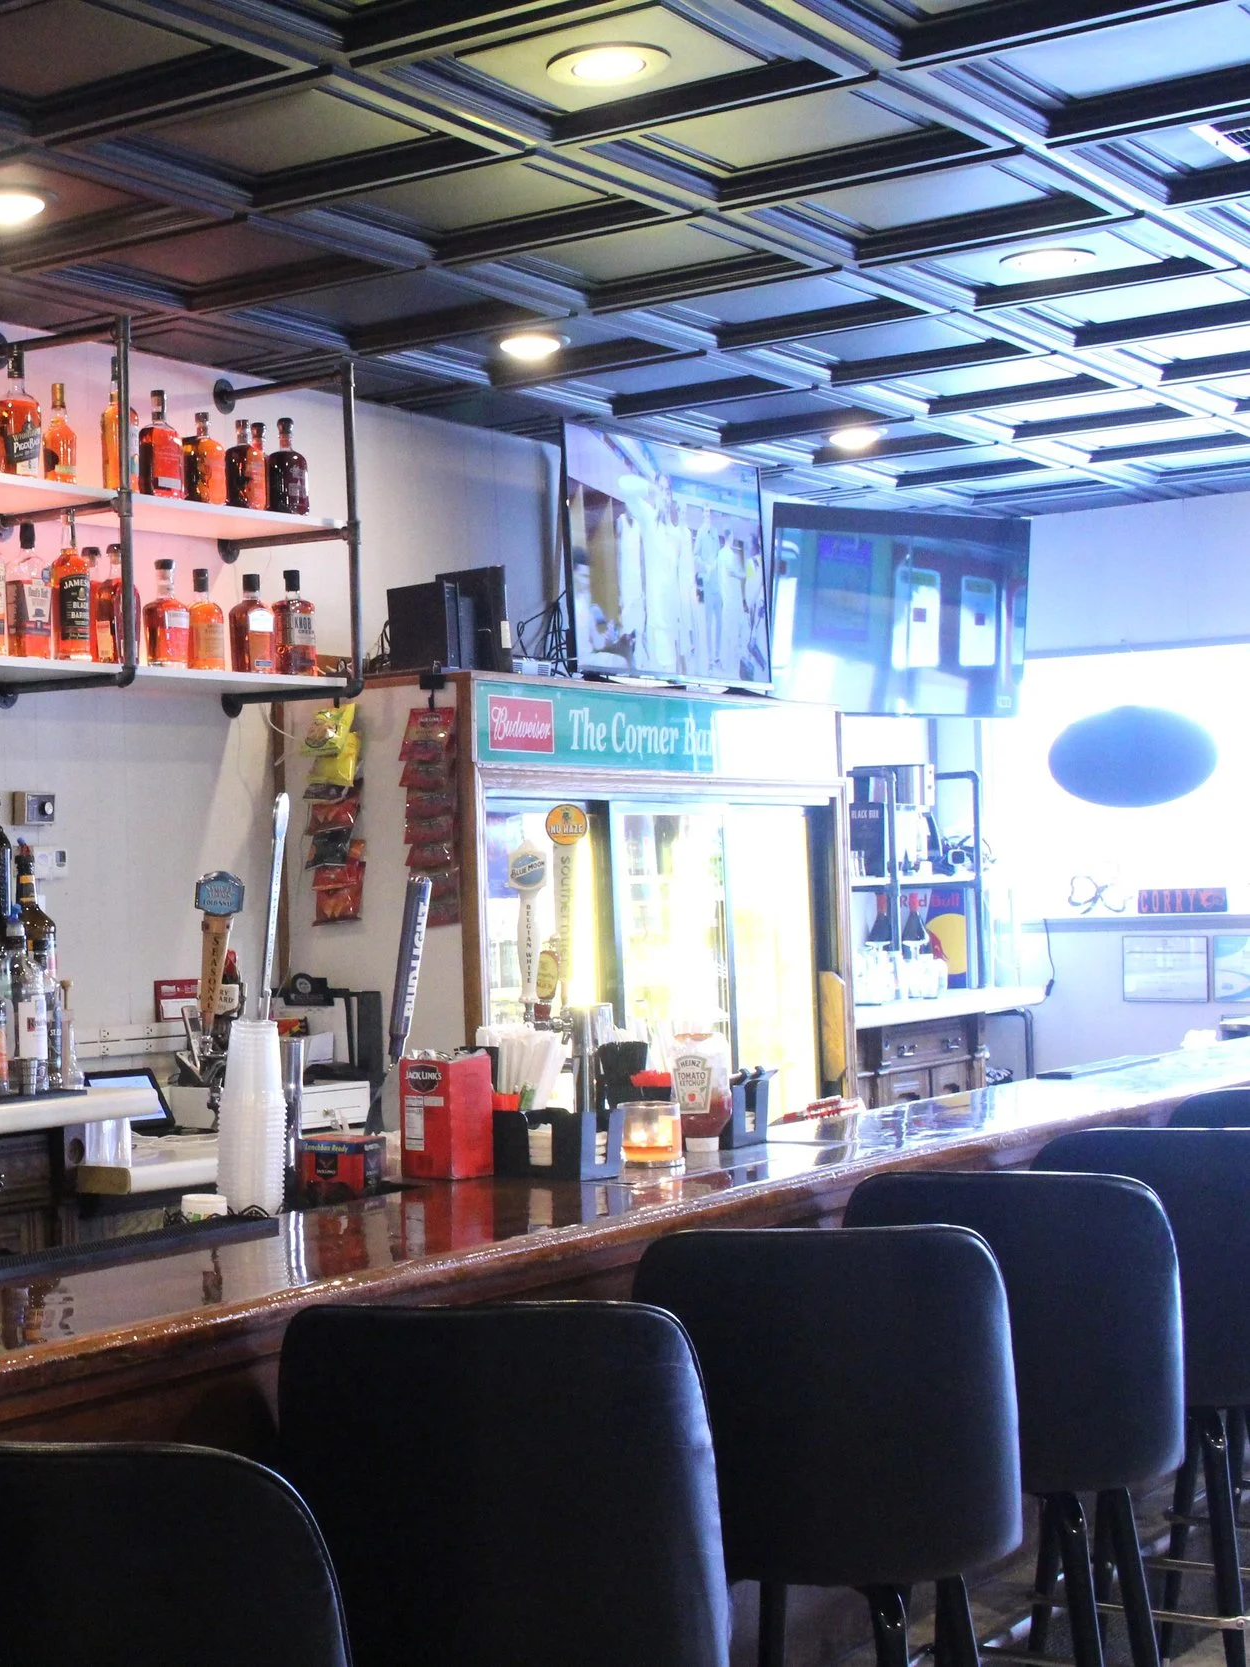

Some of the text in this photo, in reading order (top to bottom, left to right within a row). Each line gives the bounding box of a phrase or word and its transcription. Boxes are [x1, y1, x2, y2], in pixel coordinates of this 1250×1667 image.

[491, 707, 551, 740] Budweiser
[569, 708, 607, 751] The
[611, 712, 679, 756] Corner
[851, 810, 868, 819] BLACK
[510, 860, 545, 880] BLUE MOON
[900, 895, 927, 908] Rd
[1141, 888, 1197, 913] CORRY
[207, 936, 219, 1009] SEASONAL
[680, 1060, 701, 1068] HEINZ
[405, 1071, 422, 1080] JACK
[678, 1072, 705, 1080] TOMATO
[331, 1143, 348, 1153] Ready
